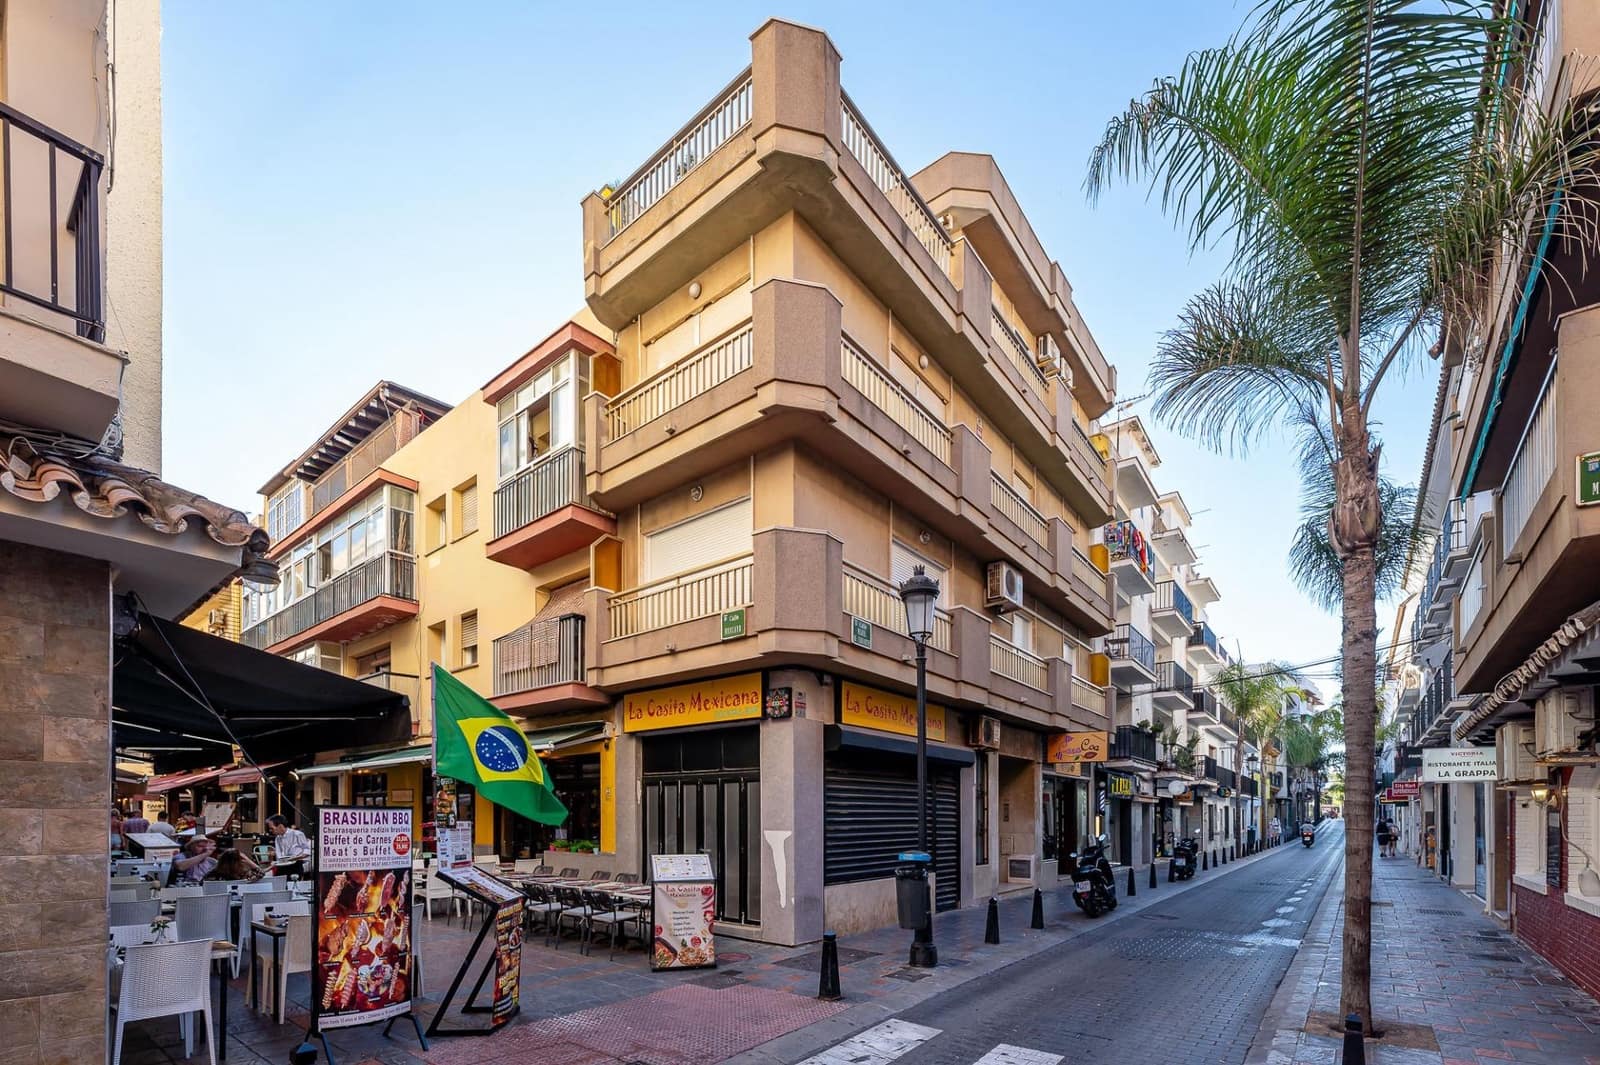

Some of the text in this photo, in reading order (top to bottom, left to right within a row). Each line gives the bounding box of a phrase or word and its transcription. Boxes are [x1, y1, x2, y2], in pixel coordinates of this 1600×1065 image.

[629, 701, 642, 720] La
[647, 699, 686, 717] Casita
[688, 689, 760, 716] Mexicana
[846, 689, 943, 729] La Casita Meana
[1454, 769, 1496, 777] GRAPPA
[323, 811, 409, 825] BRASILIAN BBQ
[323, 834, 350, 845] Buffet
[353, 834, 363, 844] de
[365, 834, 392, 844] Carnes
[363, 846, 391, 856] Buffet
[666, 884, 701, 893] La Casita
